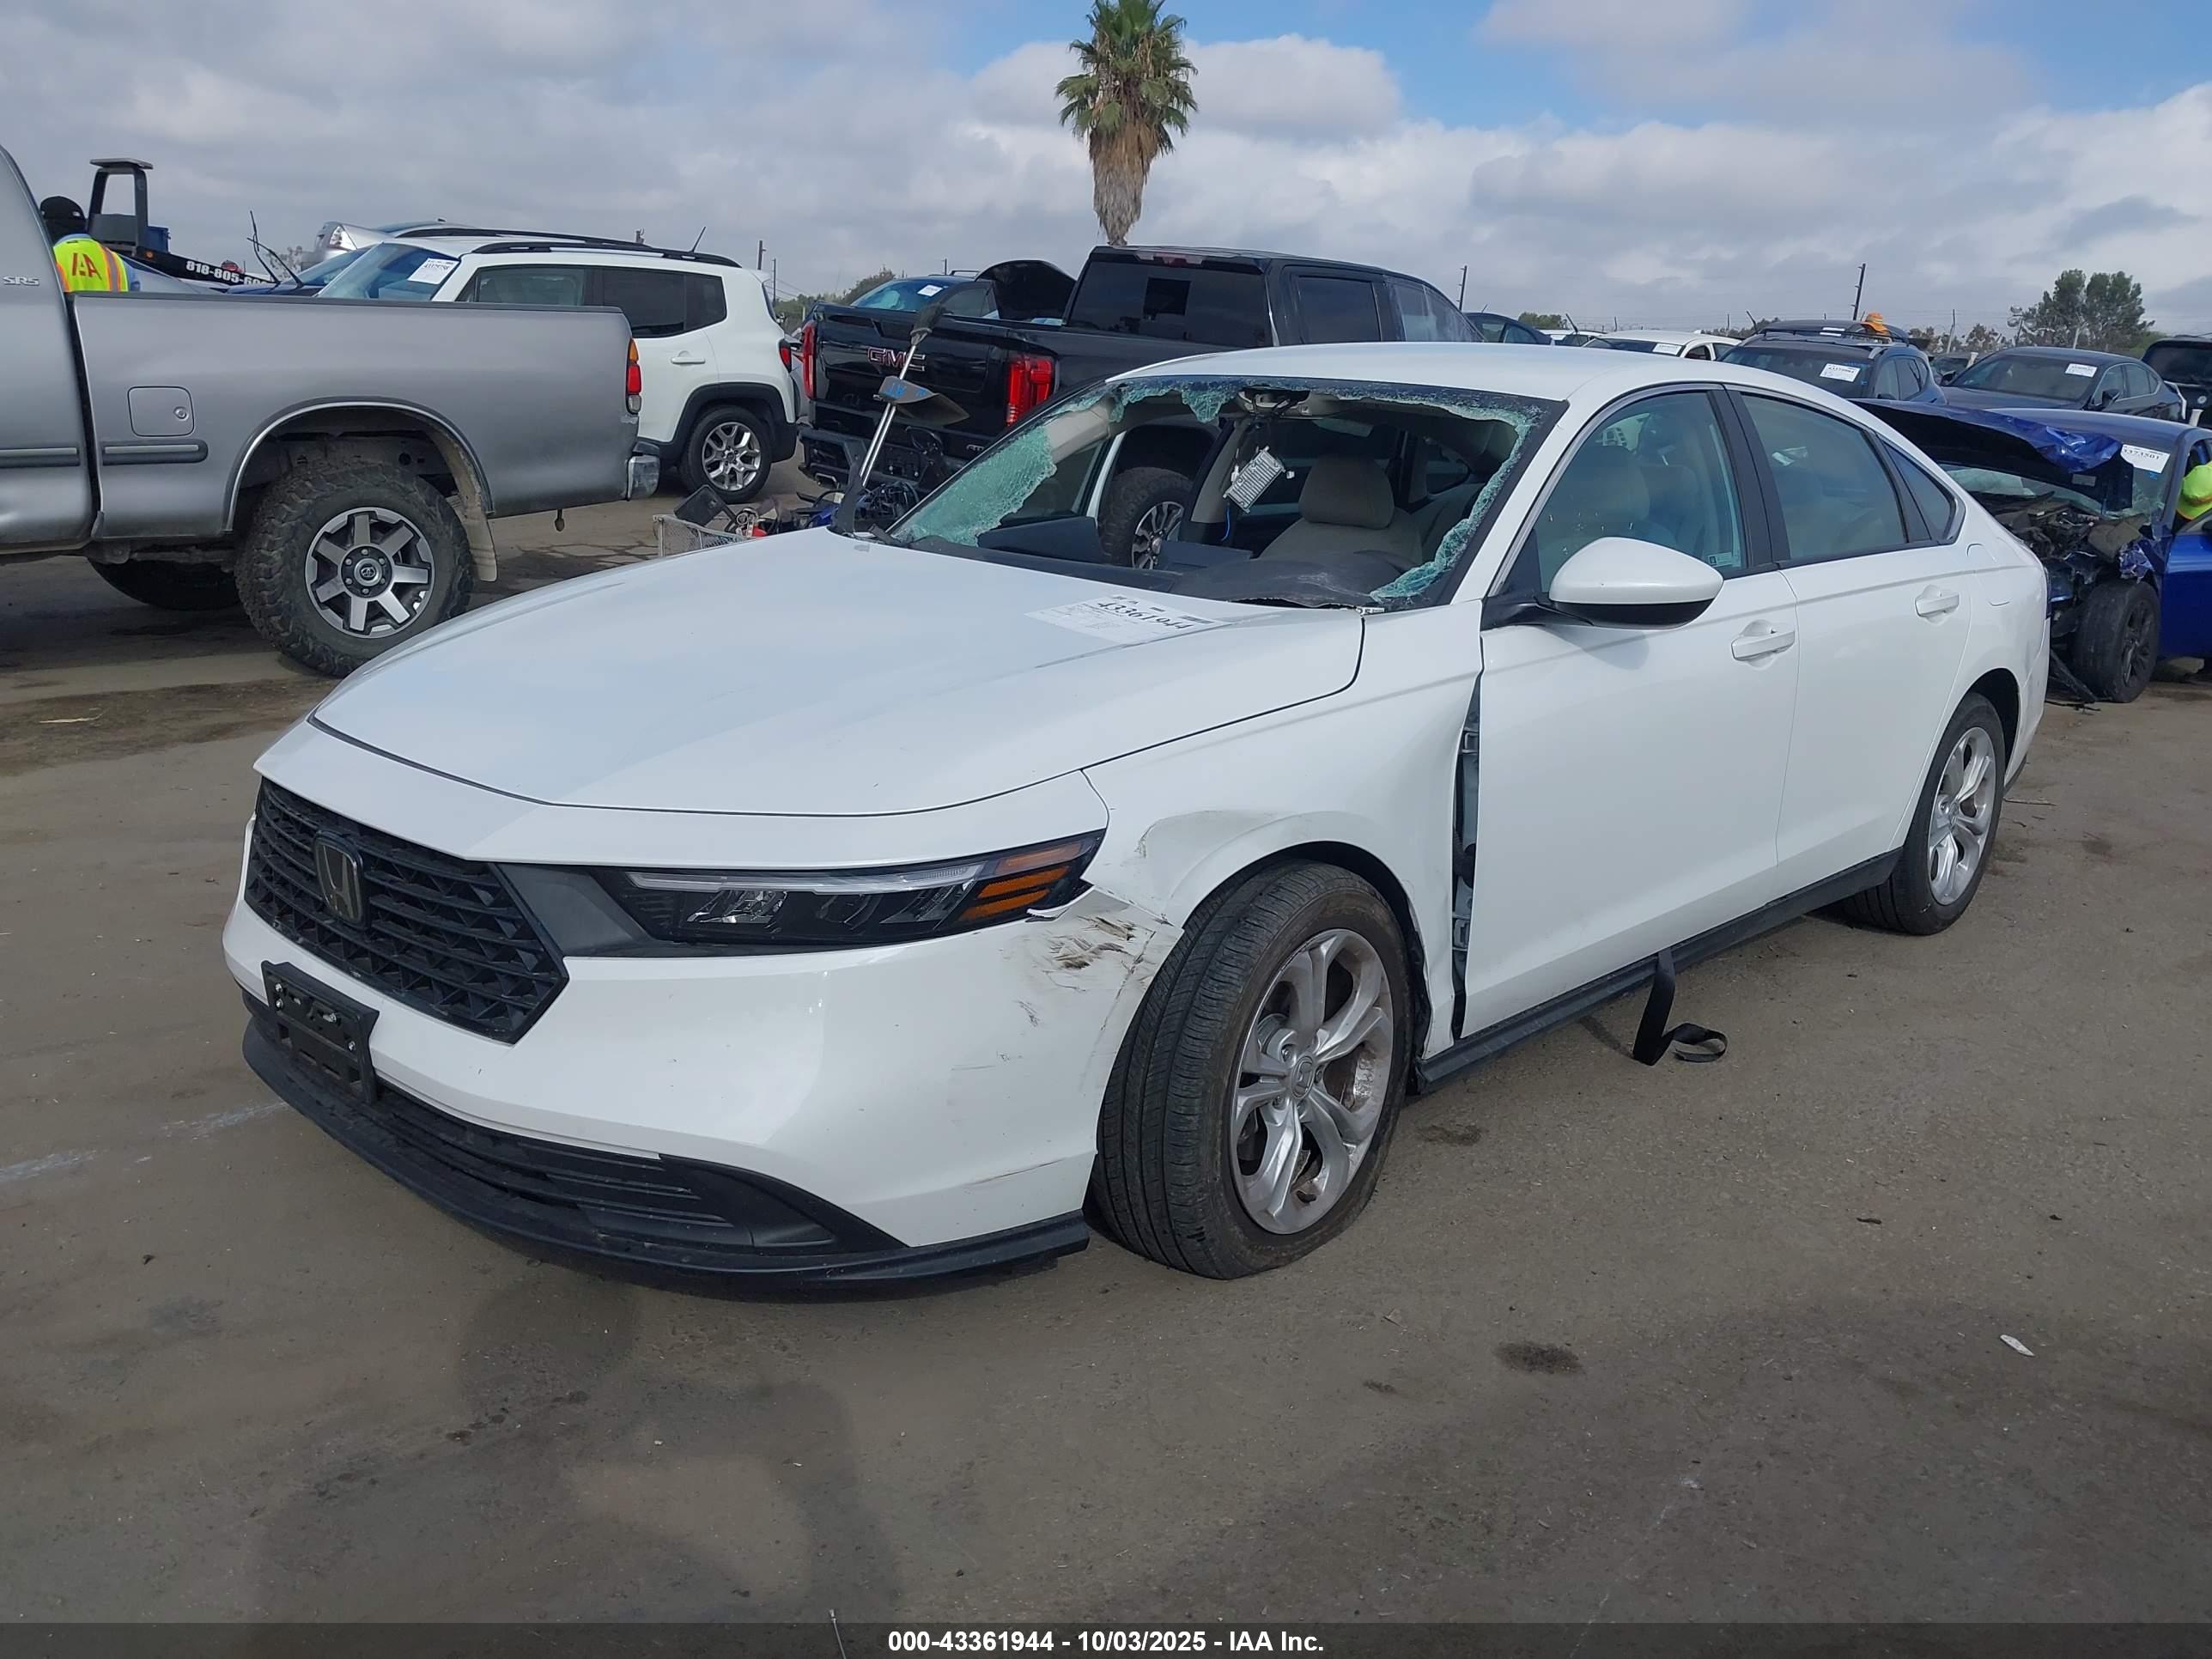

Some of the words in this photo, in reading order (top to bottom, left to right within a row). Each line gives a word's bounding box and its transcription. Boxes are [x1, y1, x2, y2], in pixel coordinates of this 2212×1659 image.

[3, 276, 40, 286] SR5
[866, 346, 926, 372] GMC
[1097, 603, 1194, 629] 43361944
